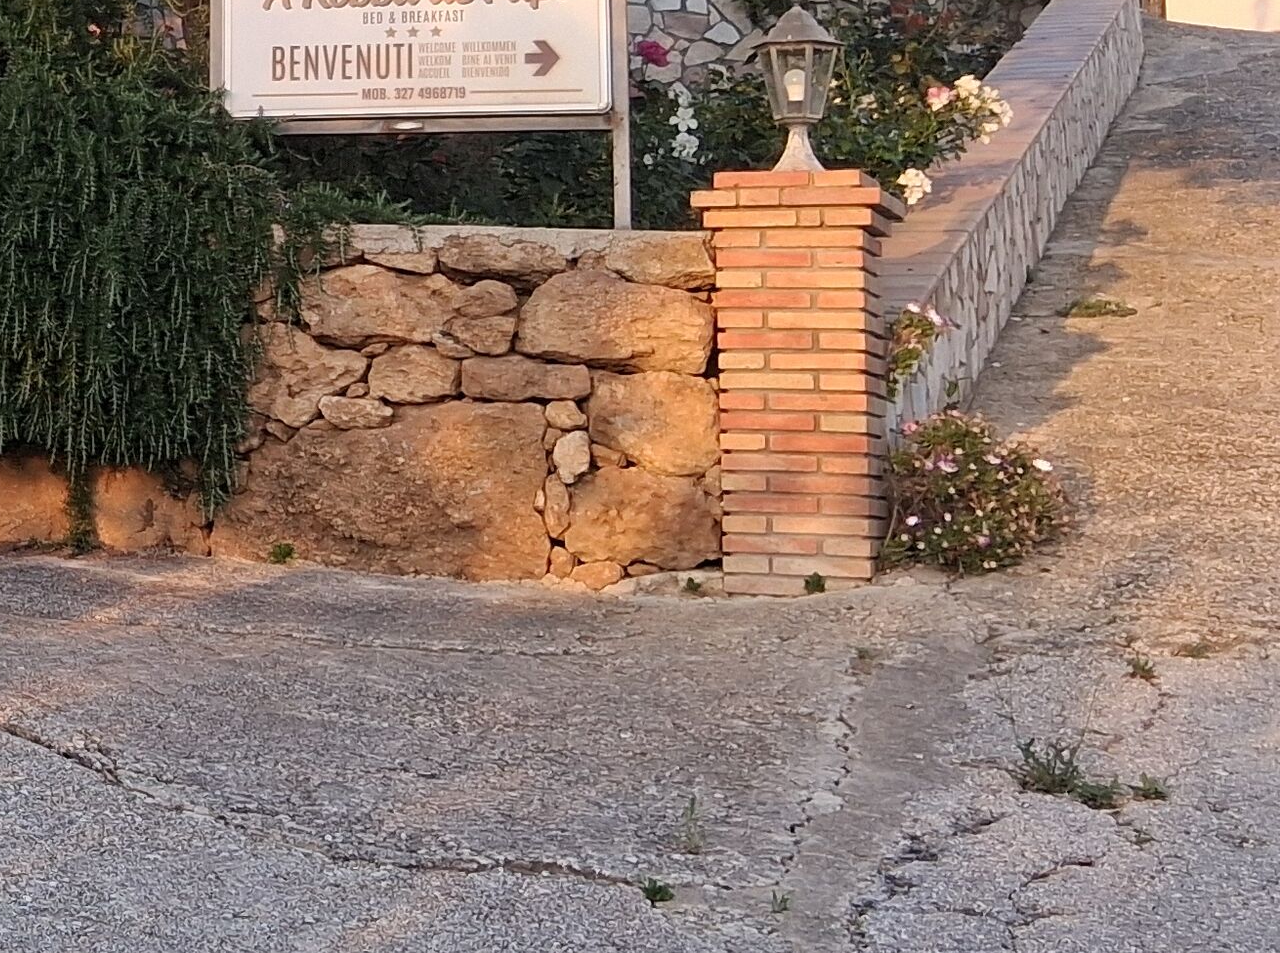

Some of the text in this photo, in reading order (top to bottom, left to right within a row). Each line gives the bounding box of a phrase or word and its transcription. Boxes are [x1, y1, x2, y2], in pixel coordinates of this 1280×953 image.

[362, 9, 465, 25] BED & BREAKFAST
[418, 42, 456, 54] WELCOME
[462, 41, 517, 53] WILLKOMMEN
[271, 43, 413, 81] BENVENUTI
[418, 55, 451, 66] WELKOM
[361, 86, 466, 100] MOB. 327 4968719
